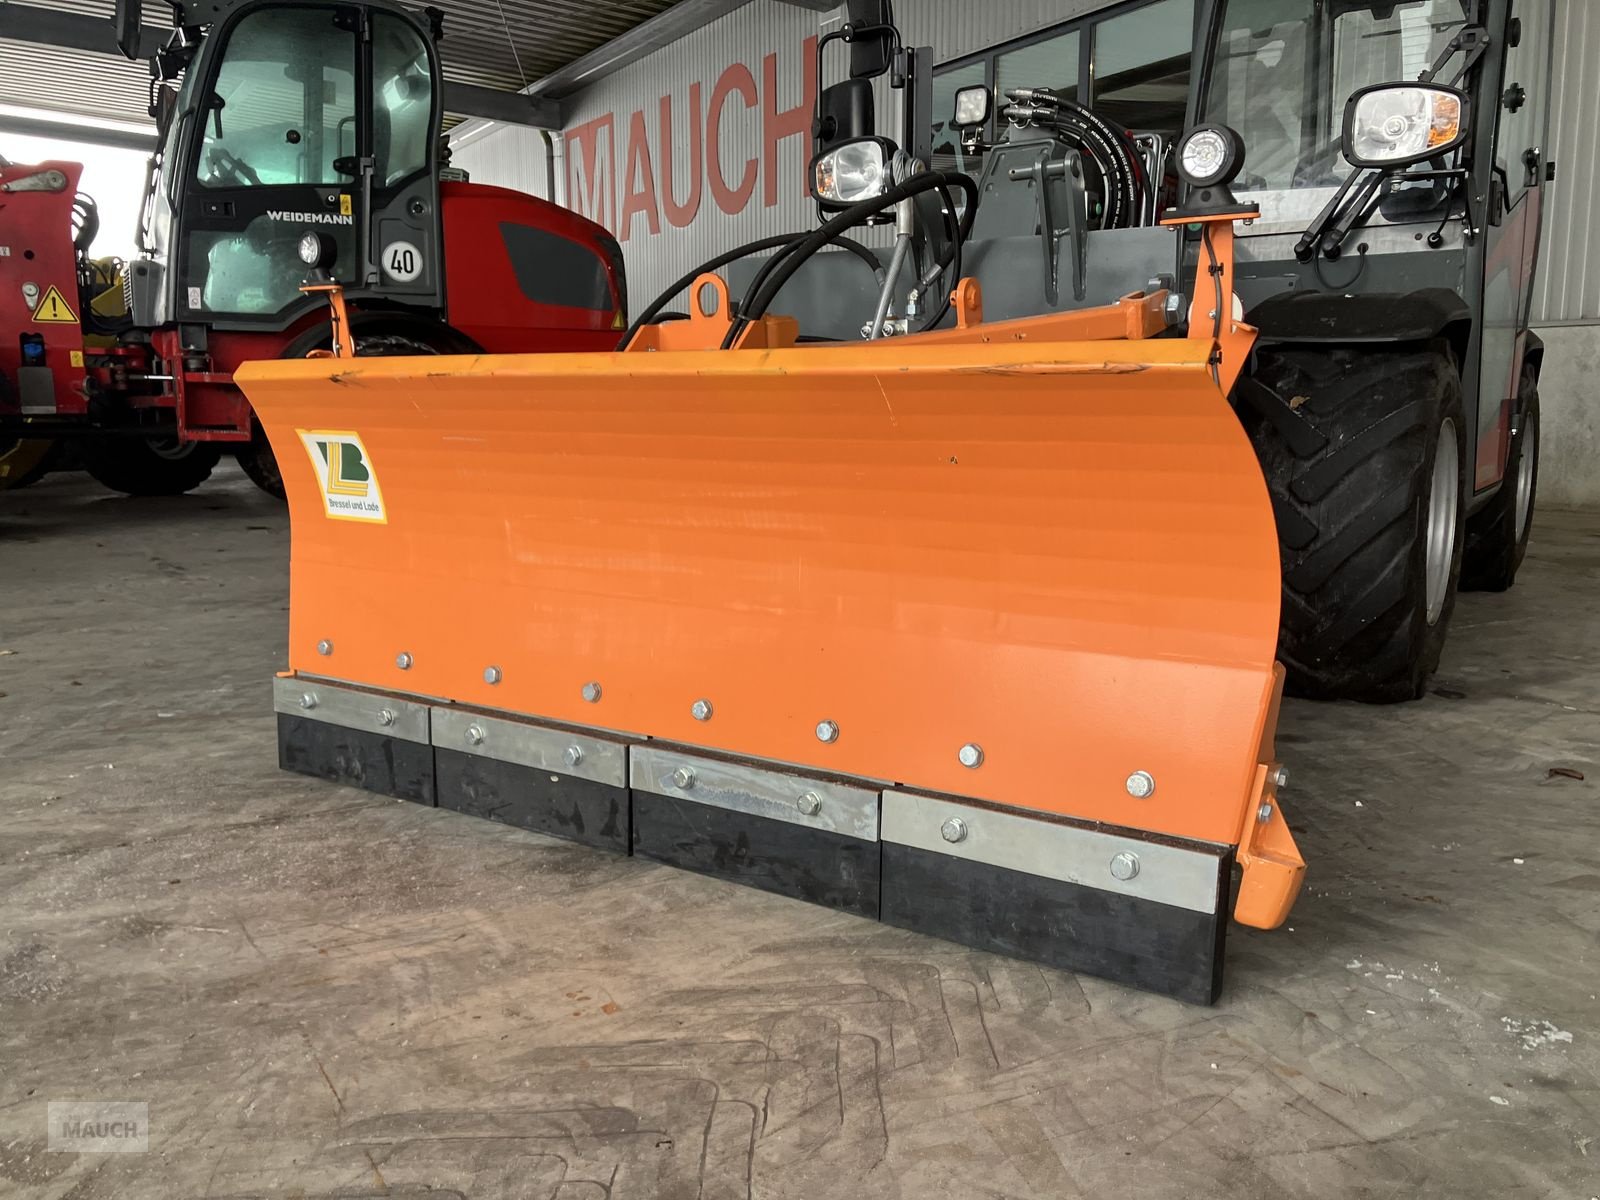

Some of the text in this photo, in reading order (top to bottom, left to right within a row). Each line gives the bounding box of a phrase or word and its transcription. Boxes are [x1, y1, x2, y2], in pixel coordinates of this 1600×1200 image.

[565, 34, 818, 242] MAUCH
[267, 210, 353, 225] WEIDEMANN
[391, 249, 414, 274] 40
[328, 498, 351, 509] Bressel
[351, 501, 363, 510] und
